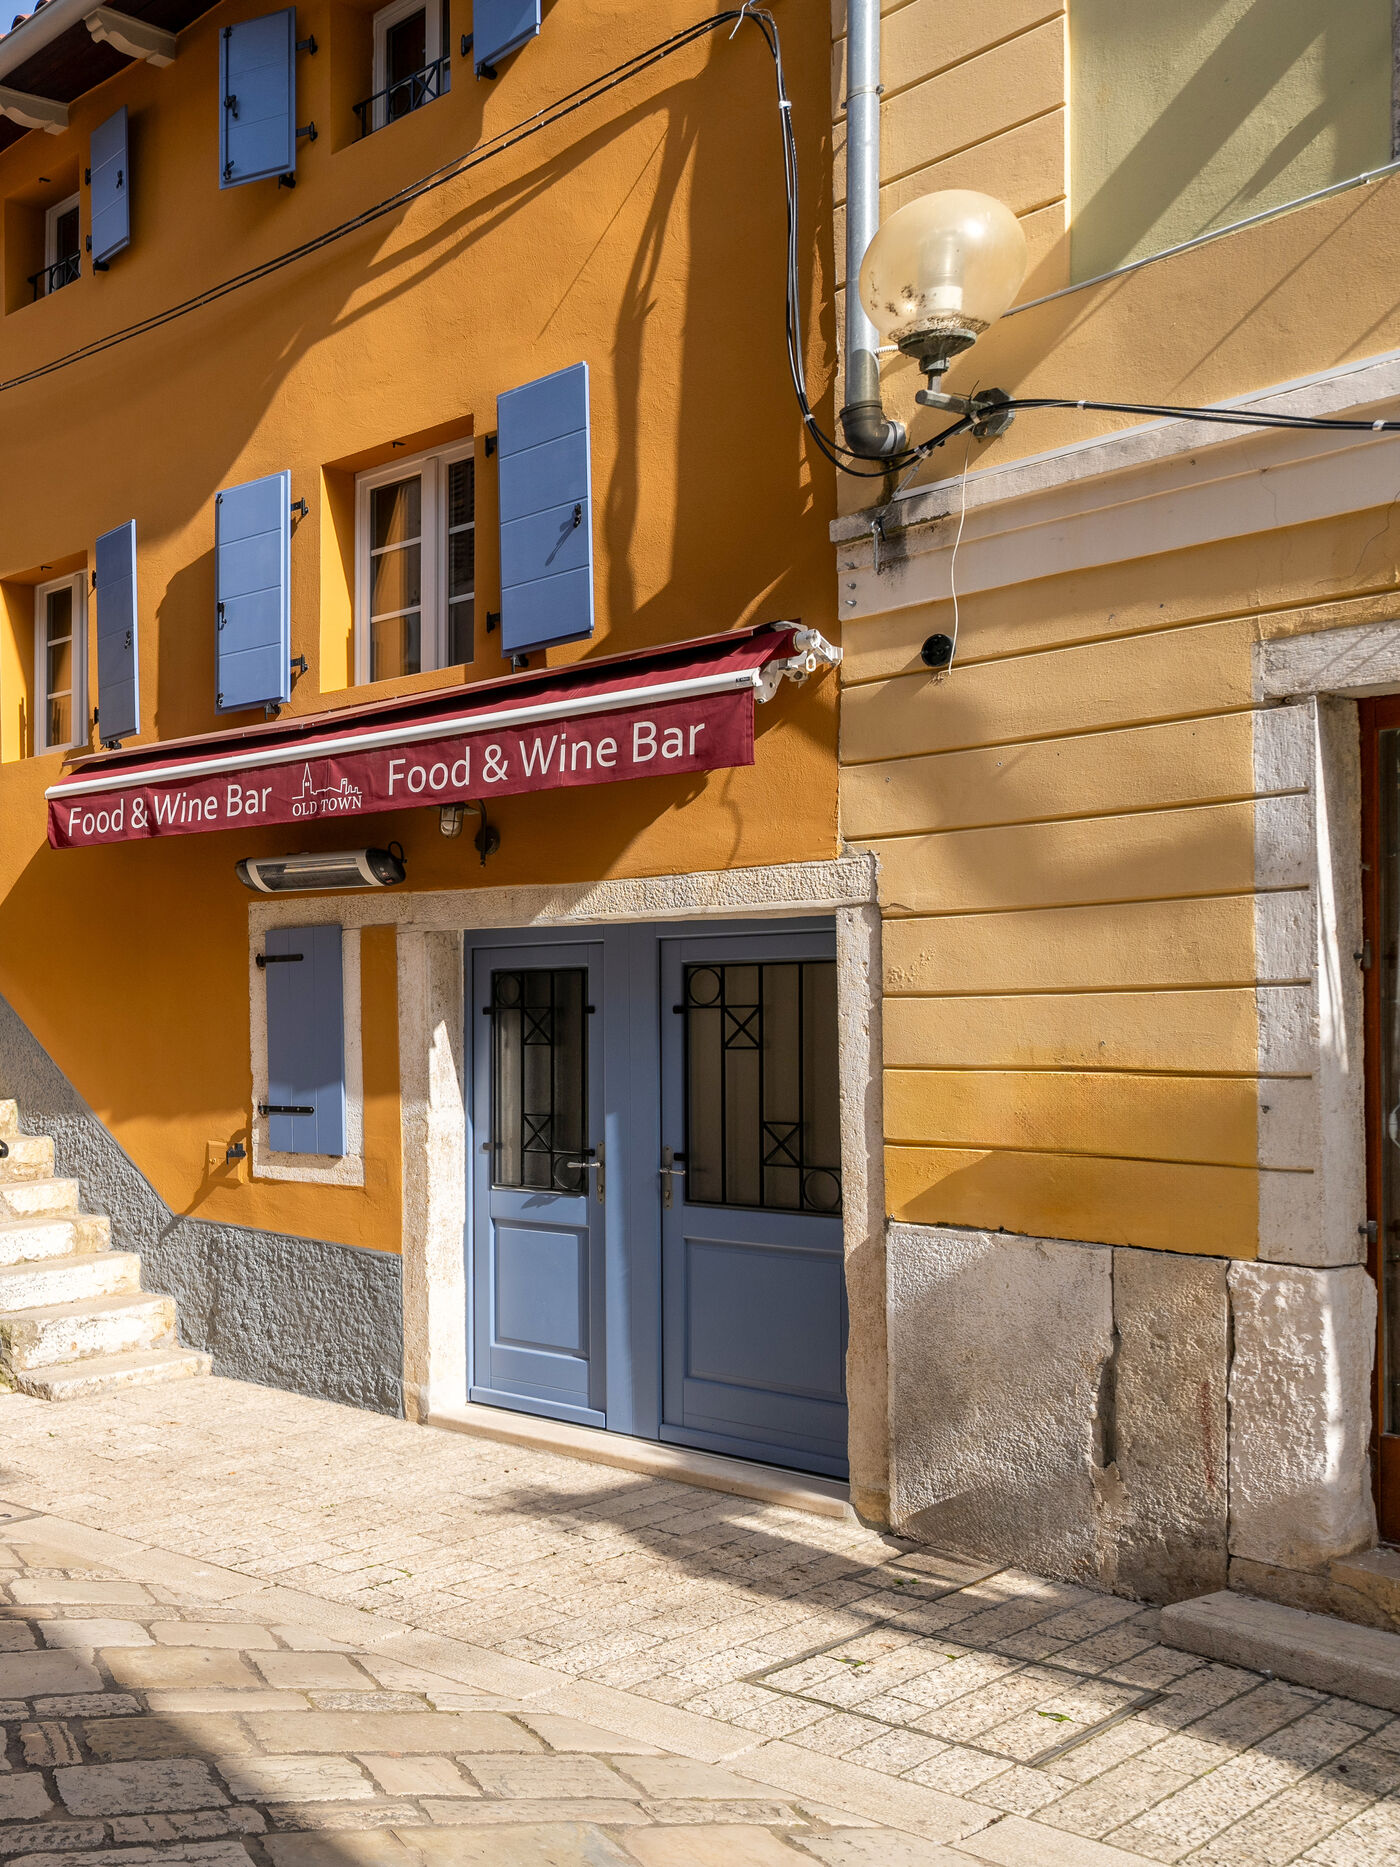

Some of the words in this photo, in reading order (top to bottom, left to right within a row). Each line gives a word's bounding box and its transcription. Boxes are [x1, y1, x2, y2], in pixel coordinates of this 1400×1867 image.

[388, 745, 471, 796] Food
[482, 743, 508, 784] &
[519, 733, 618, 777] Wine
[632, 720, 706, 764] Bar
[68, 798, 125, 837] Food
[130, 797, 149, 829] &
[154, 791, 219, 826] Wine
[226, 784, 273, 817] Bar
[292, 801, 318, 817] OLD
[320, 795, 363, 812] TOWN
